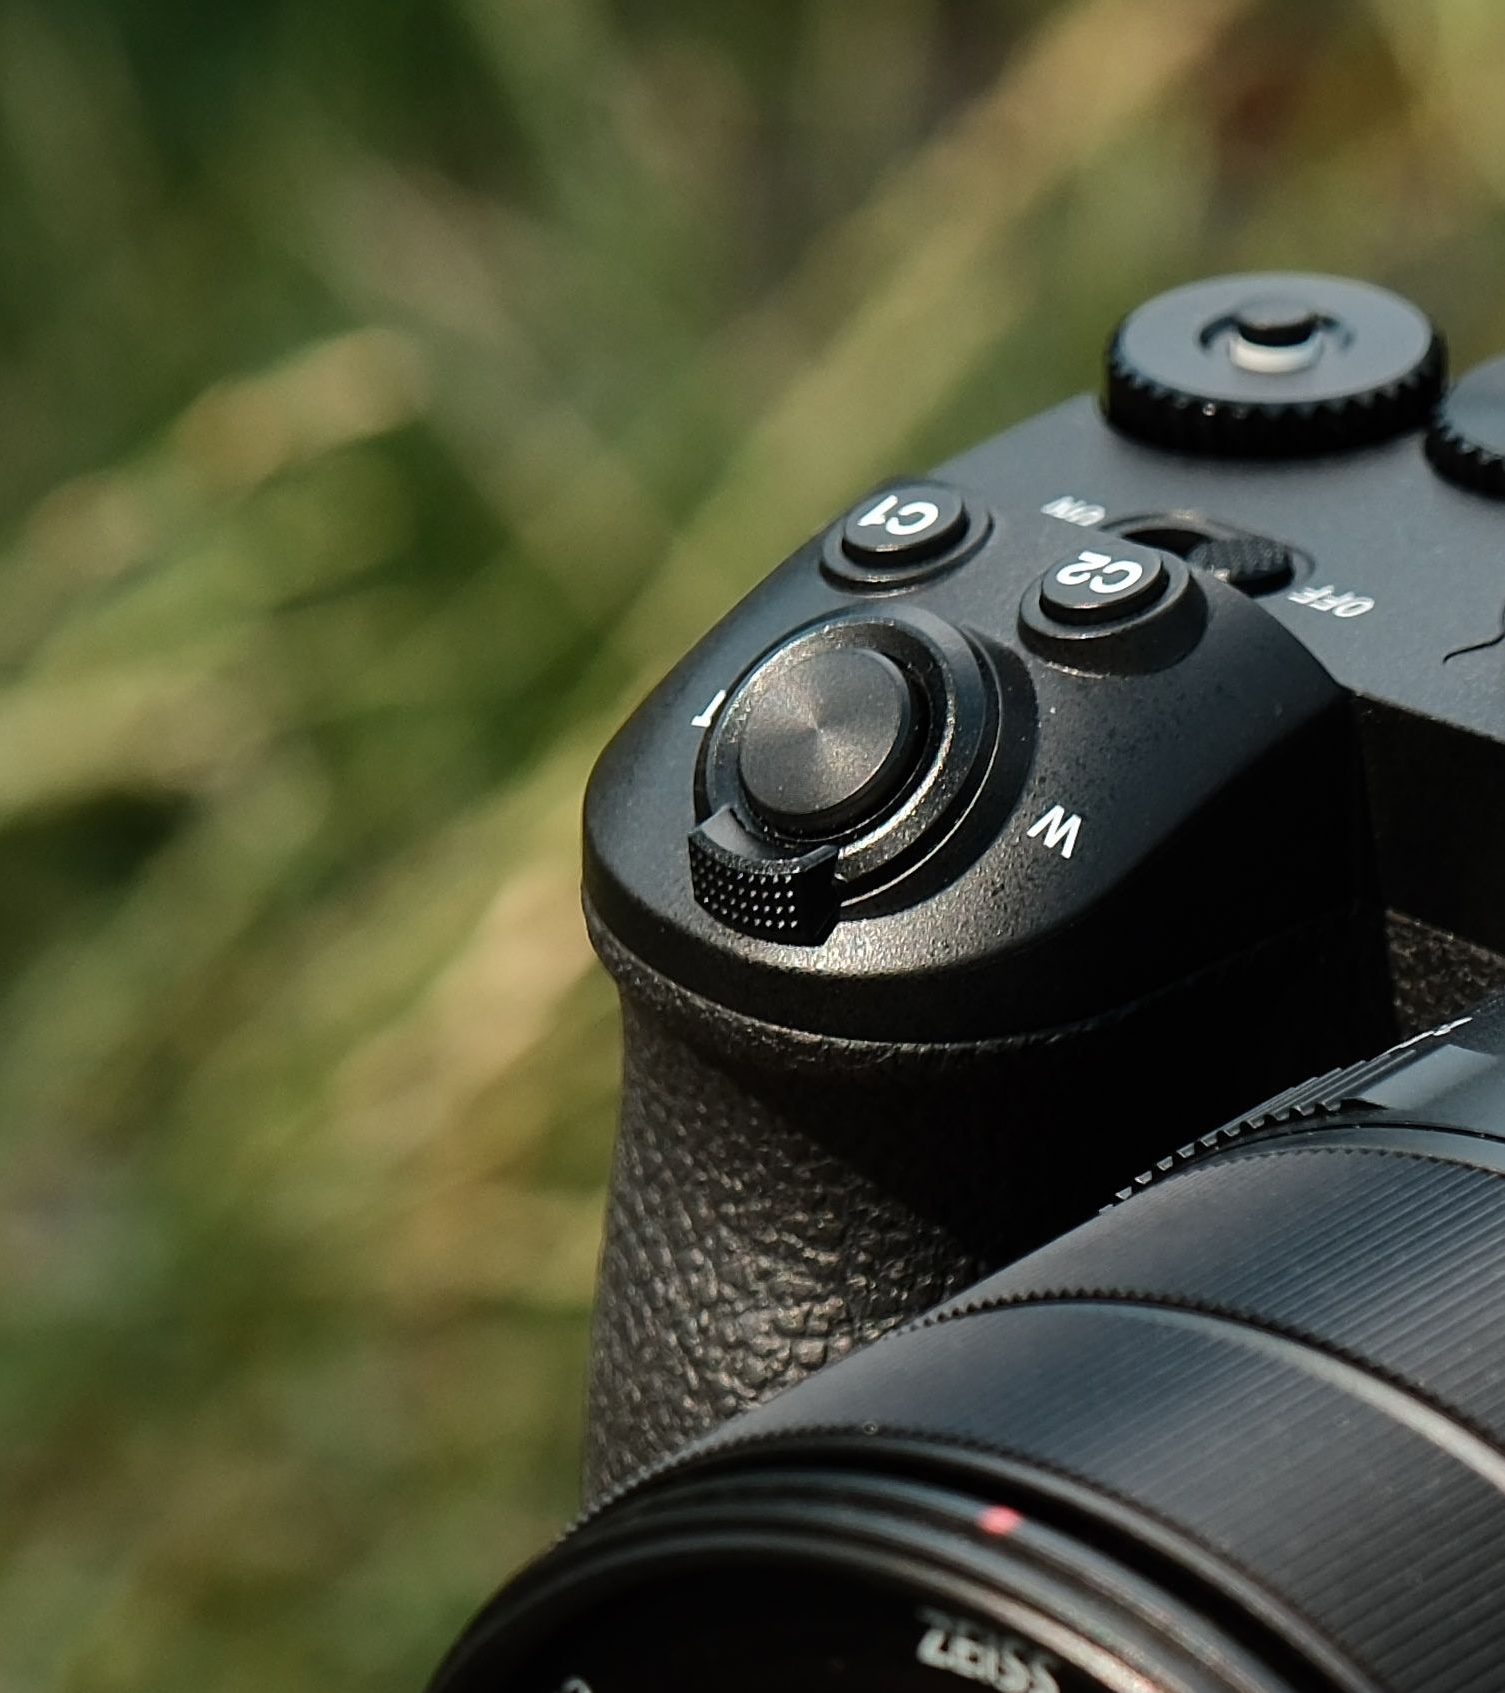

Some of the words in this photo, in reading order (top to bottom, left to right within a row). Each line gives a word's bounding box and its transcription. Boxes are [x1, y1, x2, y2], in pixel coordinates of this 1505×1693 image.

[857, 495, 939, 536] C1
[1056, 551, 1143, 594] C2
[1287, 584, 1376, 618] OFF
[1026, 805, 1082, 859] W
